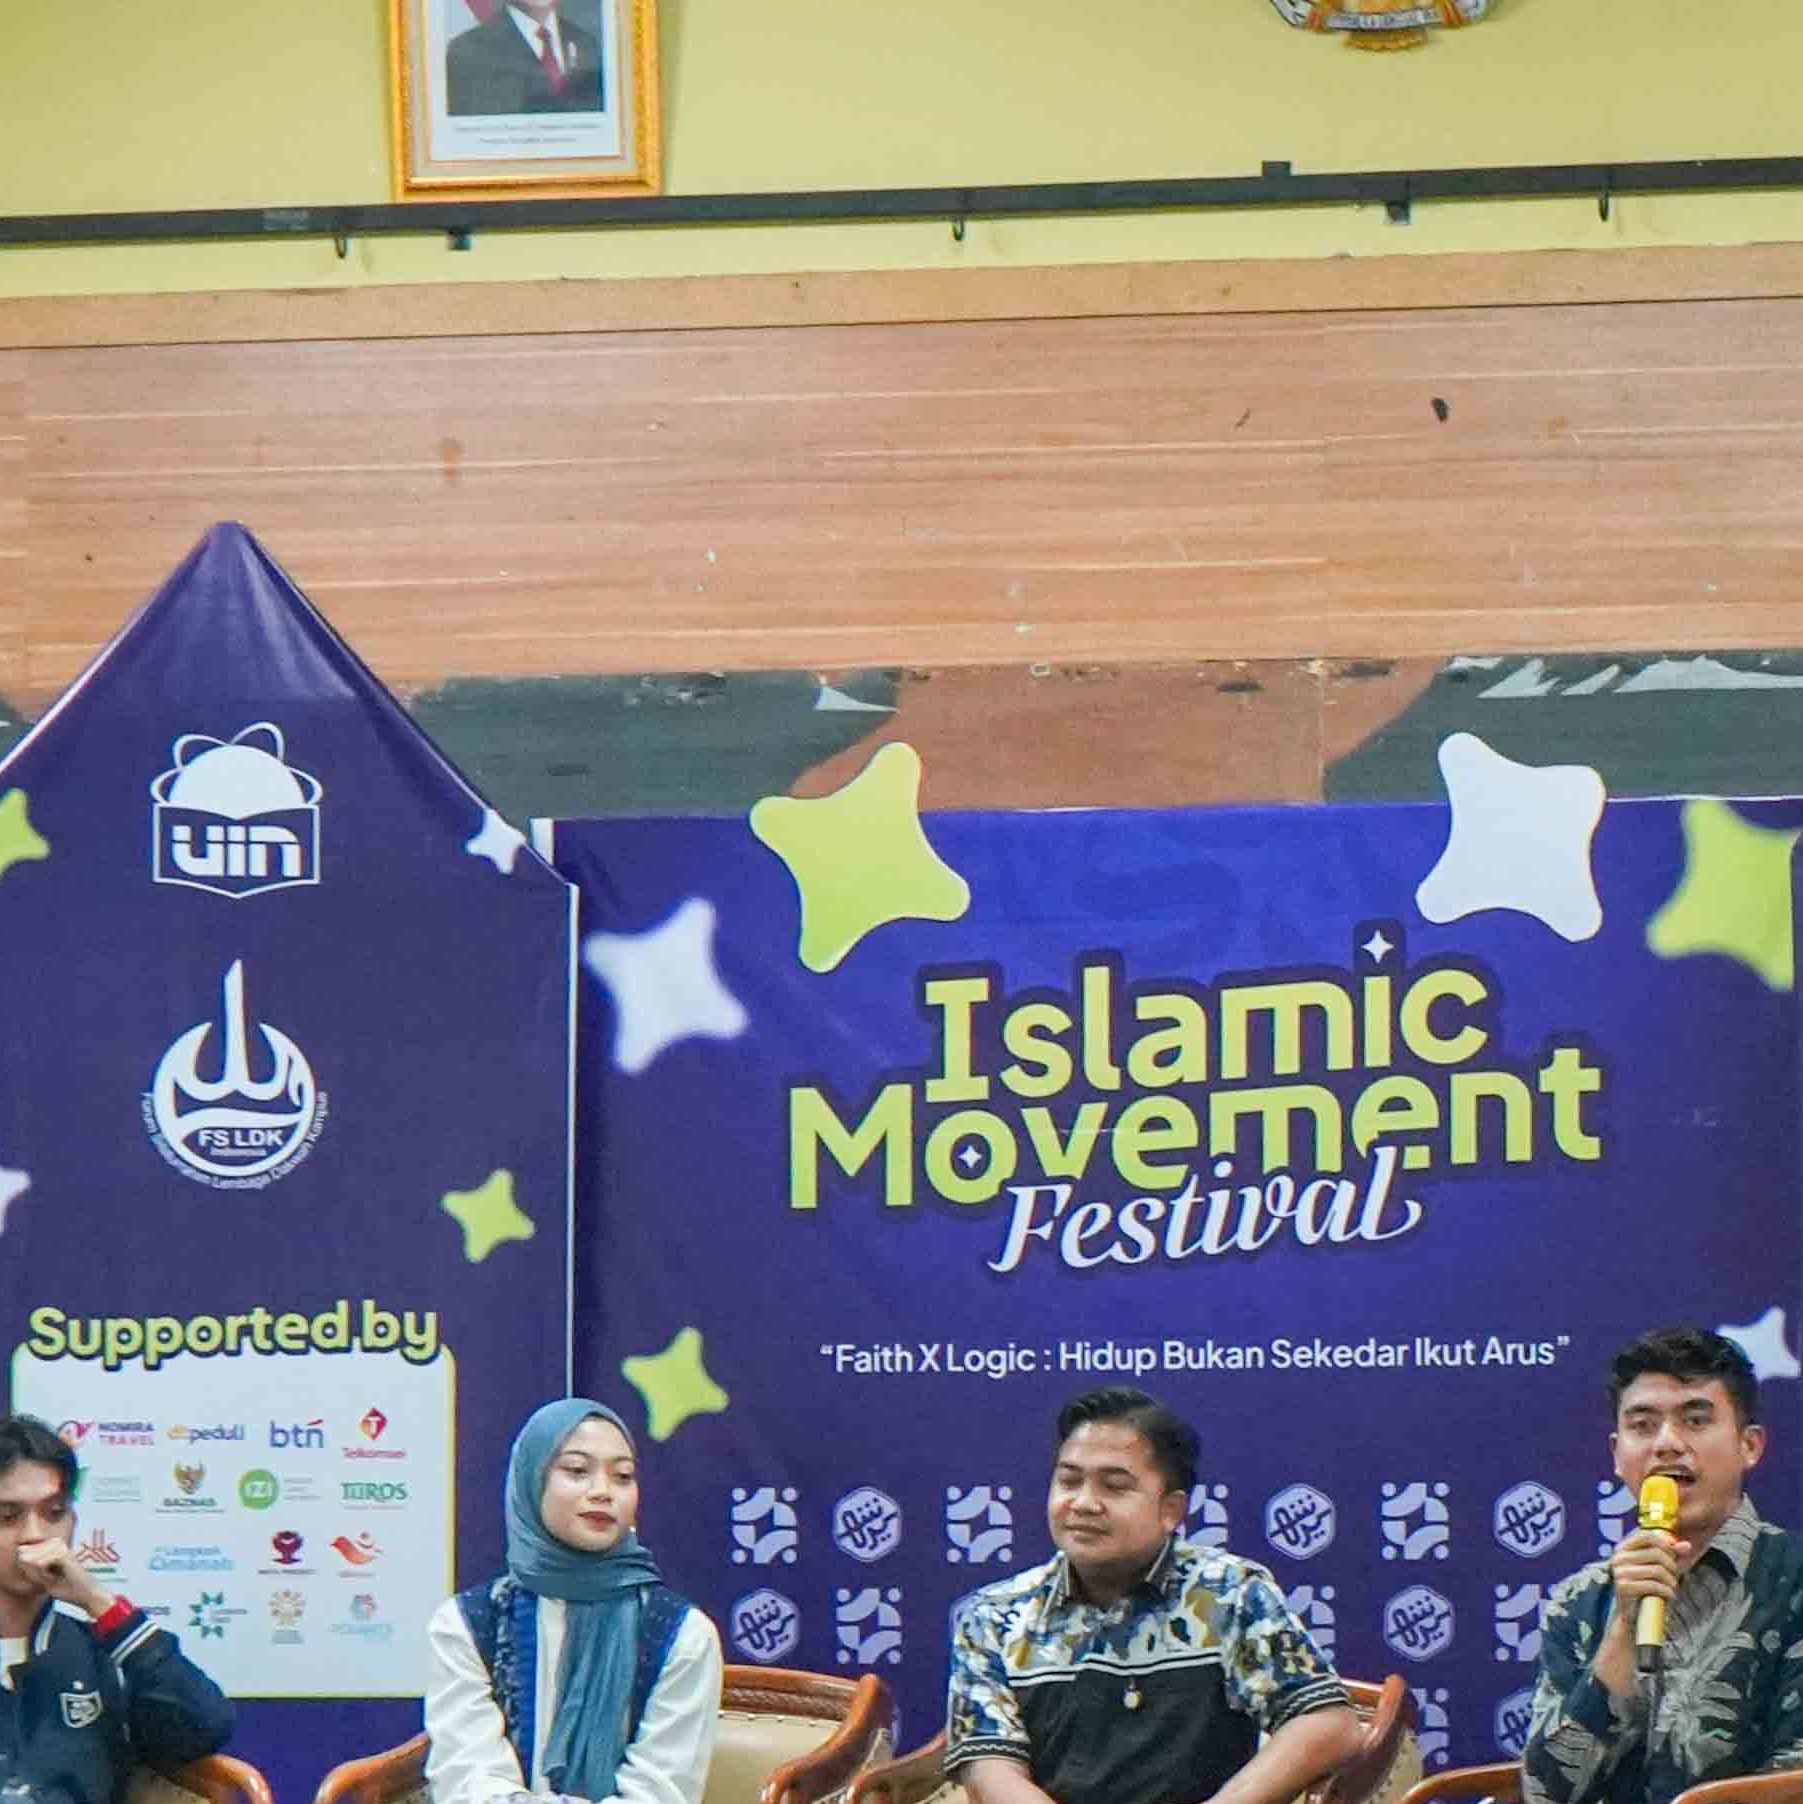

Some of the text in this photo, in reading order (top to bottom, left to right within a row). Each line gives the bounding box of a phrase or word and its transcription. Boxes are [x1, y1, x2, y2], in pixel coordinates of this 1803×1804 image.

[924, 930, 1488, 1101] Islamic
[789, 1047, 1601, 1208] Movement
[987, 1146, 1423, 1272] Festival
[28, 1300, 437, 1367] Supported by
[918, 1344, 941, 1371] X
[946, 1343, 1036, 1378] Logic
[1058, 1343, 1156, 1376] Hidup
[1164, 1338, 1264, 1370] Bukan
[1271, 1338, 1409, 1369] Sekedar
[1415, 1338, 1476, 1367] Ikut
